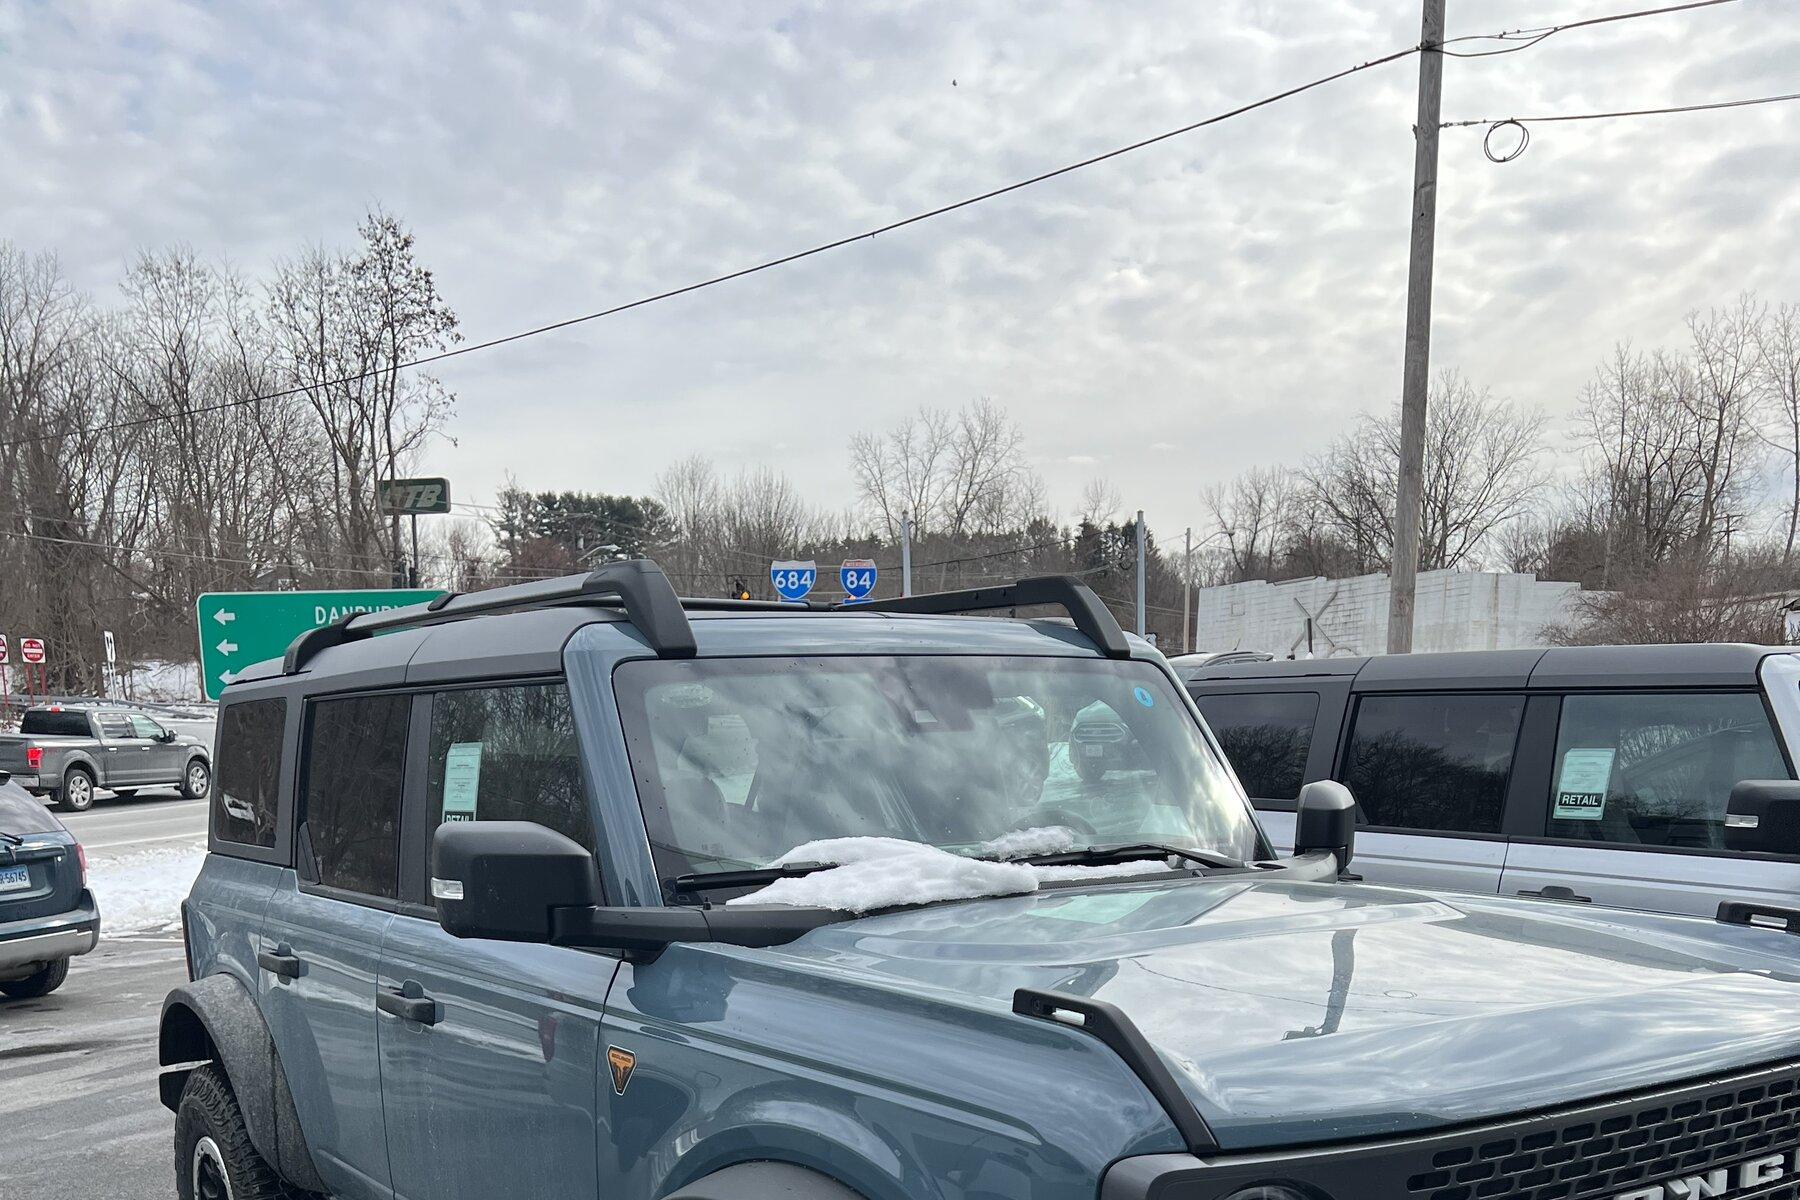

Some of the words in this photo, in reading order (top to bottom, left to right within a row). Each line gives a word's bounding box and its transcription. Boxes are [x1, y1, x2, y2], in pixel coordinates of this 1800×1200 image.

[775, 570, 812, 590] 684
[846, 570, 872, 589] 84
[1561, 794, 1599, 806] RETAIL
